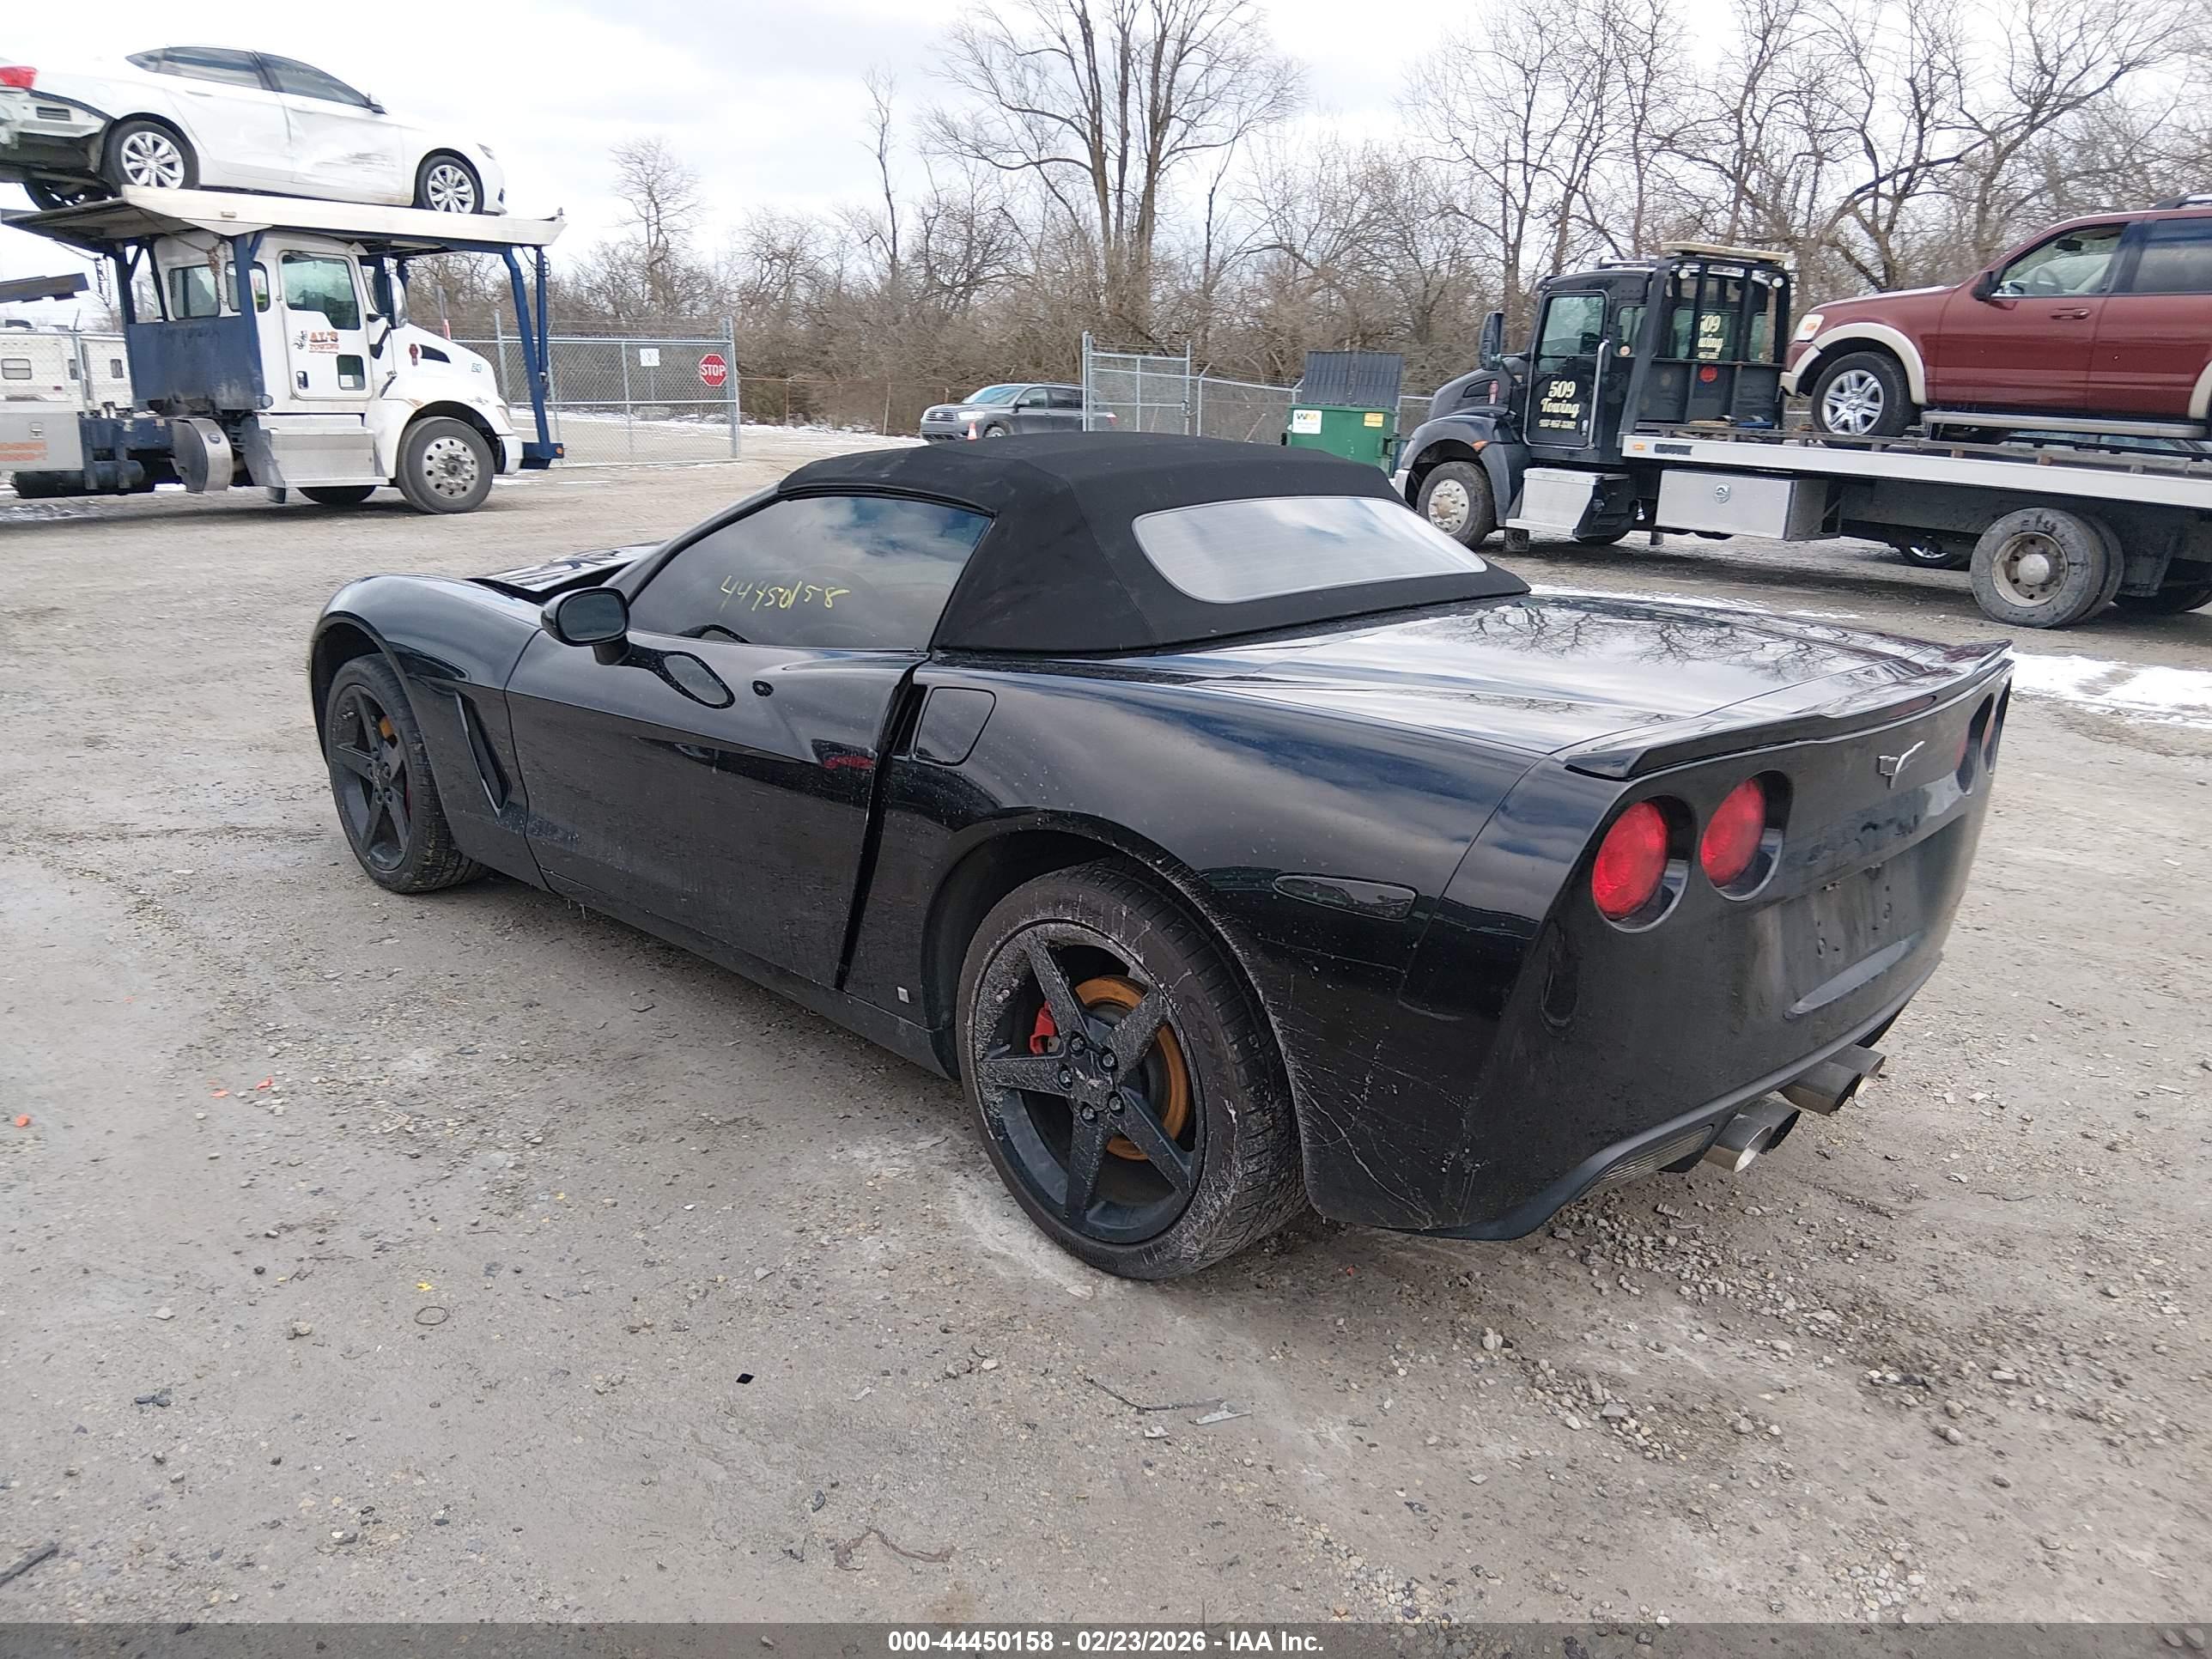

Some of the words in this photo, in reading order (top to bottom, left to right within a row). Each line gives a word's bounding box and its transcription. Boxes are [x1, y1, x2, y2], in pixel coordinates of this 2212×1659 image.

[701, 364, 726, 376] STOP
[1548, 380, 1576, 398] 509
[1540, 398, 1580, 418] Towing
